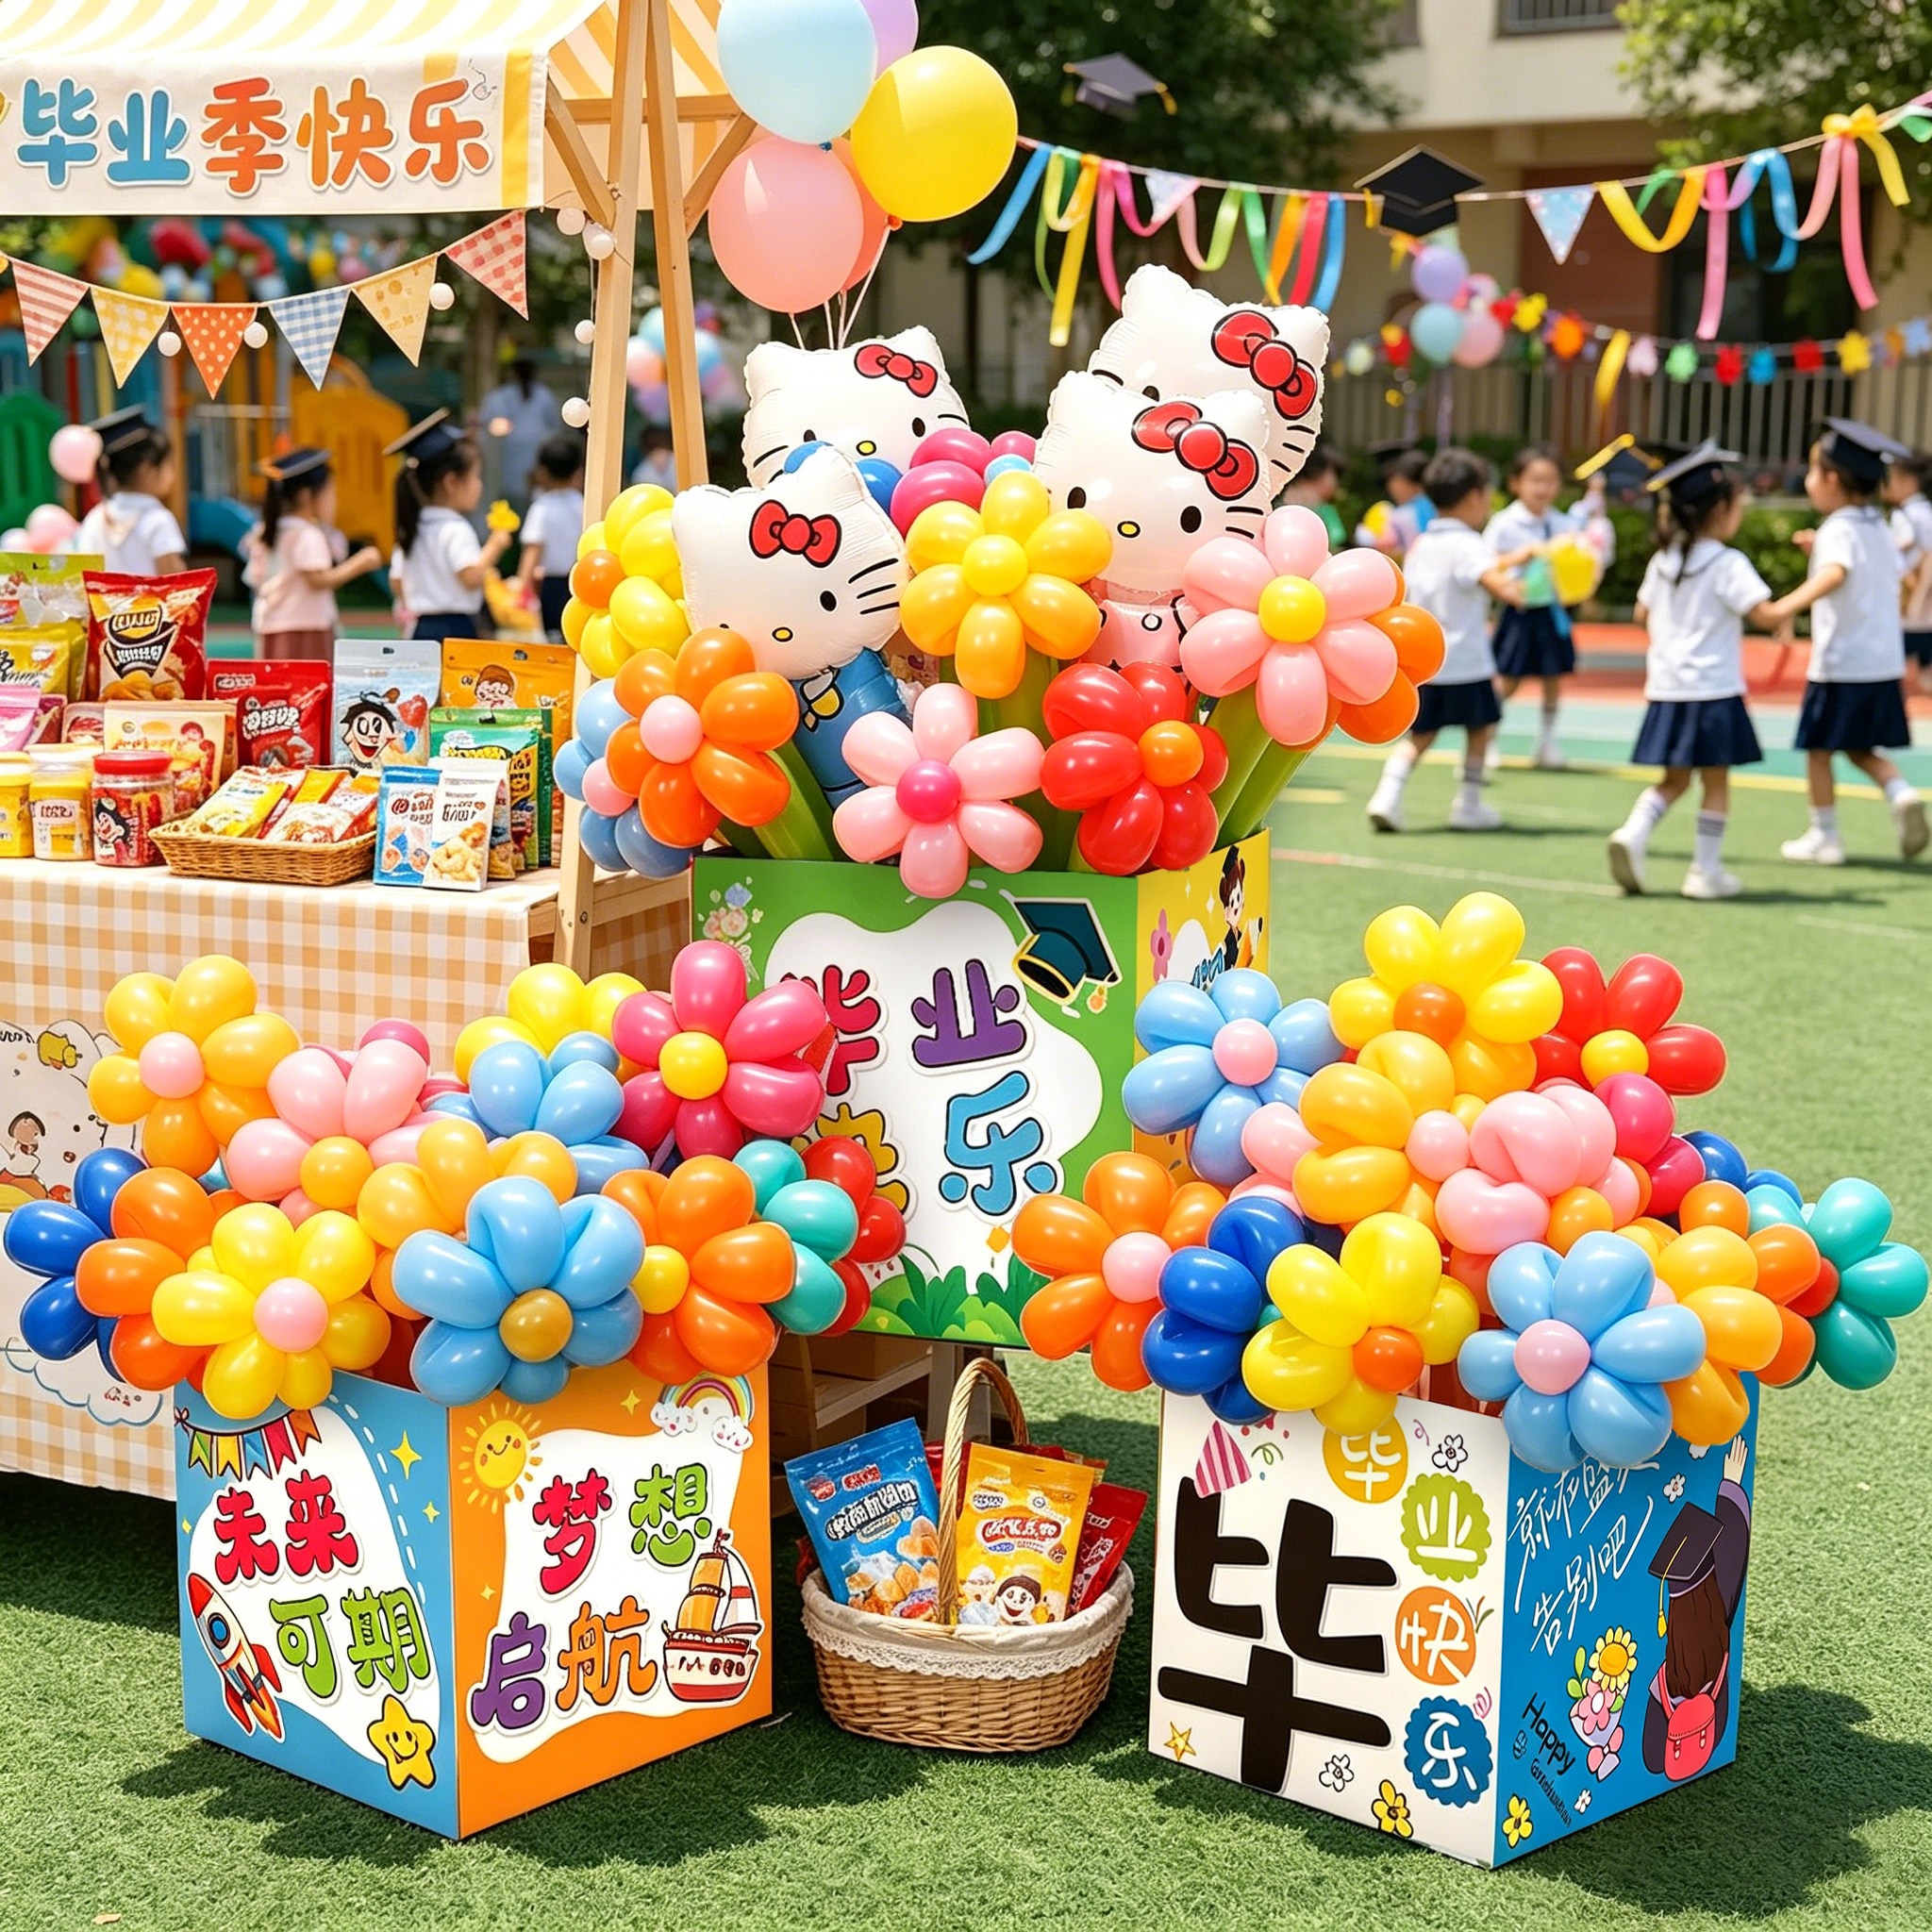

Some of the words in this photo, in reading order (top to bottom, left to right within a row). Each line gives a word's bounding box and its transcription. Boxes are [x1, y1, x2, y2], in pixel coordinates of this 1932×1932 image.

[17, 77, 491, 193] 毕业季快乐
[214, 1469, 359, 1586] 未来
[532, 1461, 712, 1595] 梦想
[1530, 1494, 1655, 1657] 告别吧
[268, 1586, 430, 1699] 可期
[472, 1594, 658, 1730] 启航
[1158, 1475, 1398, 1793] 毕
[1522, 1691, 1576, 1775] Happy
